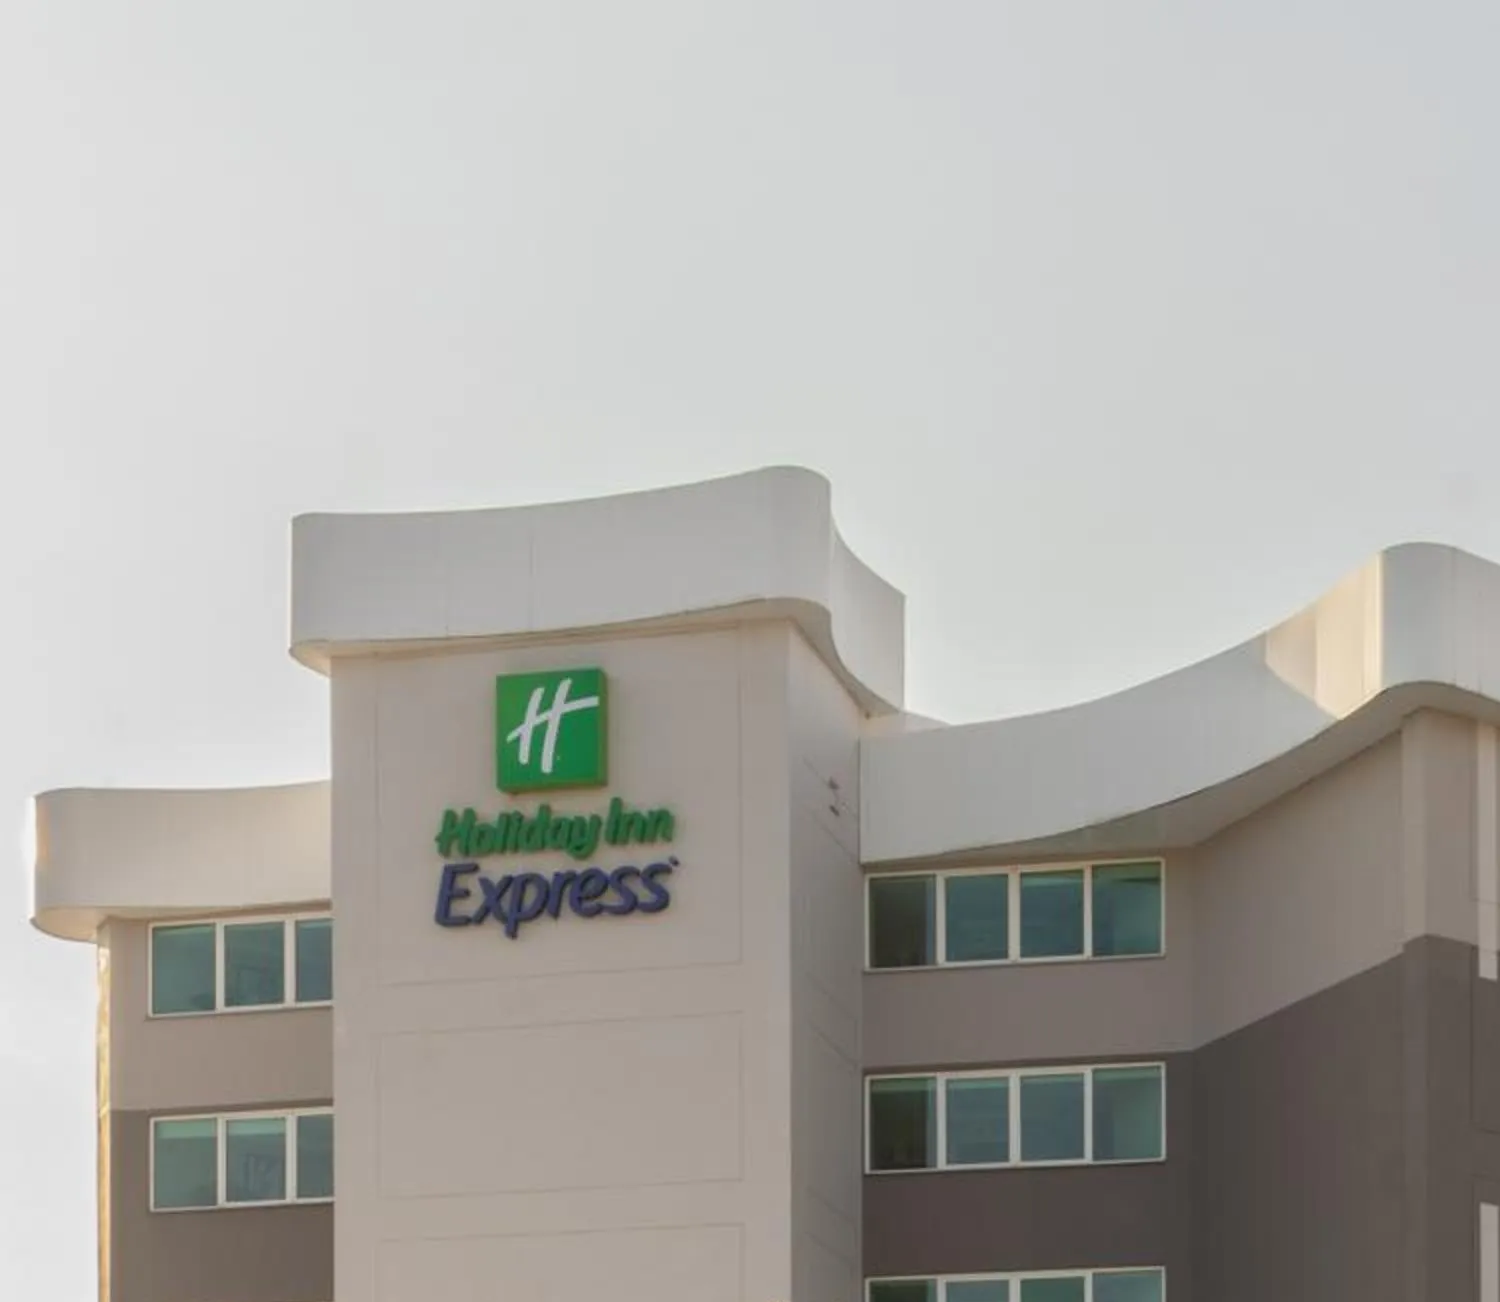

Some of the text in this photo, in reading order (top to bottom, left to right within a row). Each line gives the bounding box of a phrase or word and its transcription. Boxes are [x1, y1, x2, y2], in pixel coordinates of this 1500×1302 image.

[435, 797, 675, 861] Holiday Inn
[434, 862, 674, 939] Express
